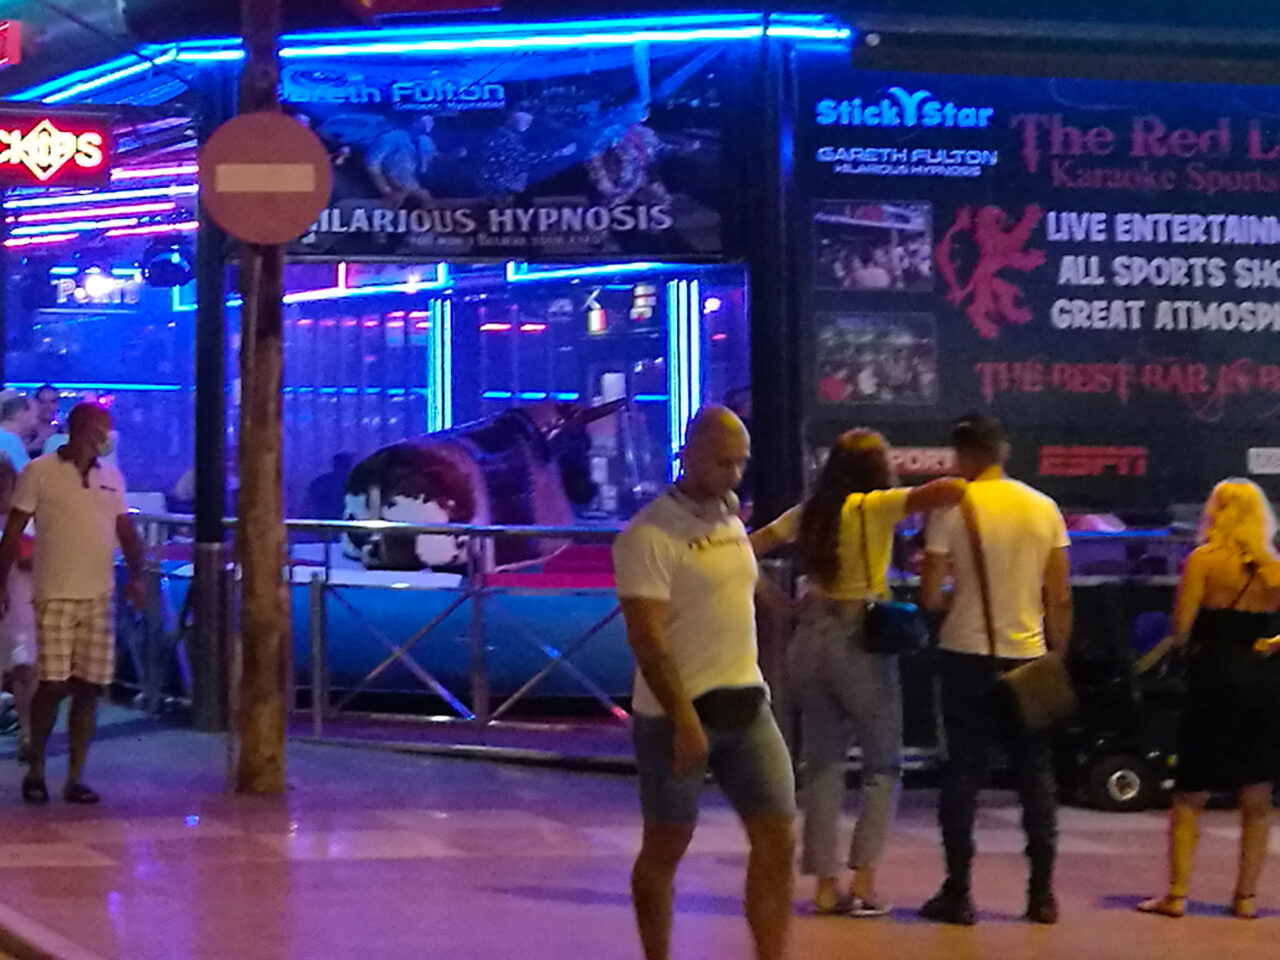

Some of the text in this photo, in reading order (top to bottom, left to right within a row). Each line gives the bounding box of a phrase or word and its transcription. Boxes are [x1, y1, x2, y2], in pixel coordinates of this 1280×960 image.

[392, 80, 506, 103] Fulton
[816, 147, 998, 166] GARETH FULTON
[1010, 113, 1115, 173] The
[1129, 114, 1232, 158] Red
[304, 203, 675, 235] ILARIOUS HYPNOSIS
[1046, 210, 1107, 241] LIVE
[1057, 255, 1106, 285] ALL
[1112, 254, 1227, 287] SPORTS
[1049, 297, 1146, 330] GREAT
[1039, 445, 1147, 476] ESPN
